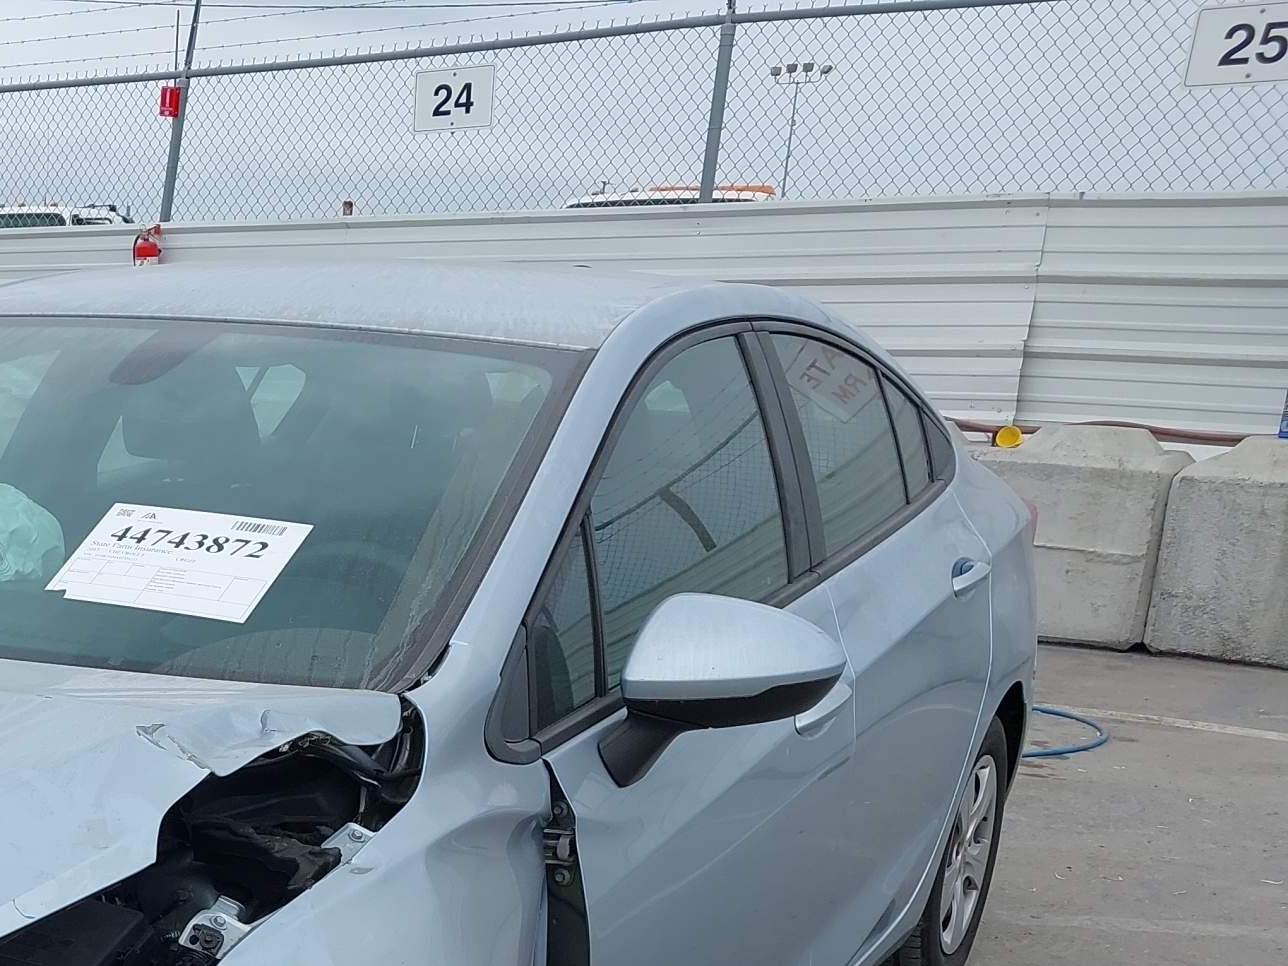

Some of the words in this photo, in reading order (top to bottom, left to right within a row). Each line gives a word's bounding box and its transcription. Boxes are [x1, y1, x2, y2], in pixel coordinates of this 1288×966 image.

[1217, 21, 1288, 66] 25
[432, 82, 474, 117] 24
[91, 540, 111, 548] State
[112, 542, 133, 550] Farm
[110, 525, 270, 559] 44743872
